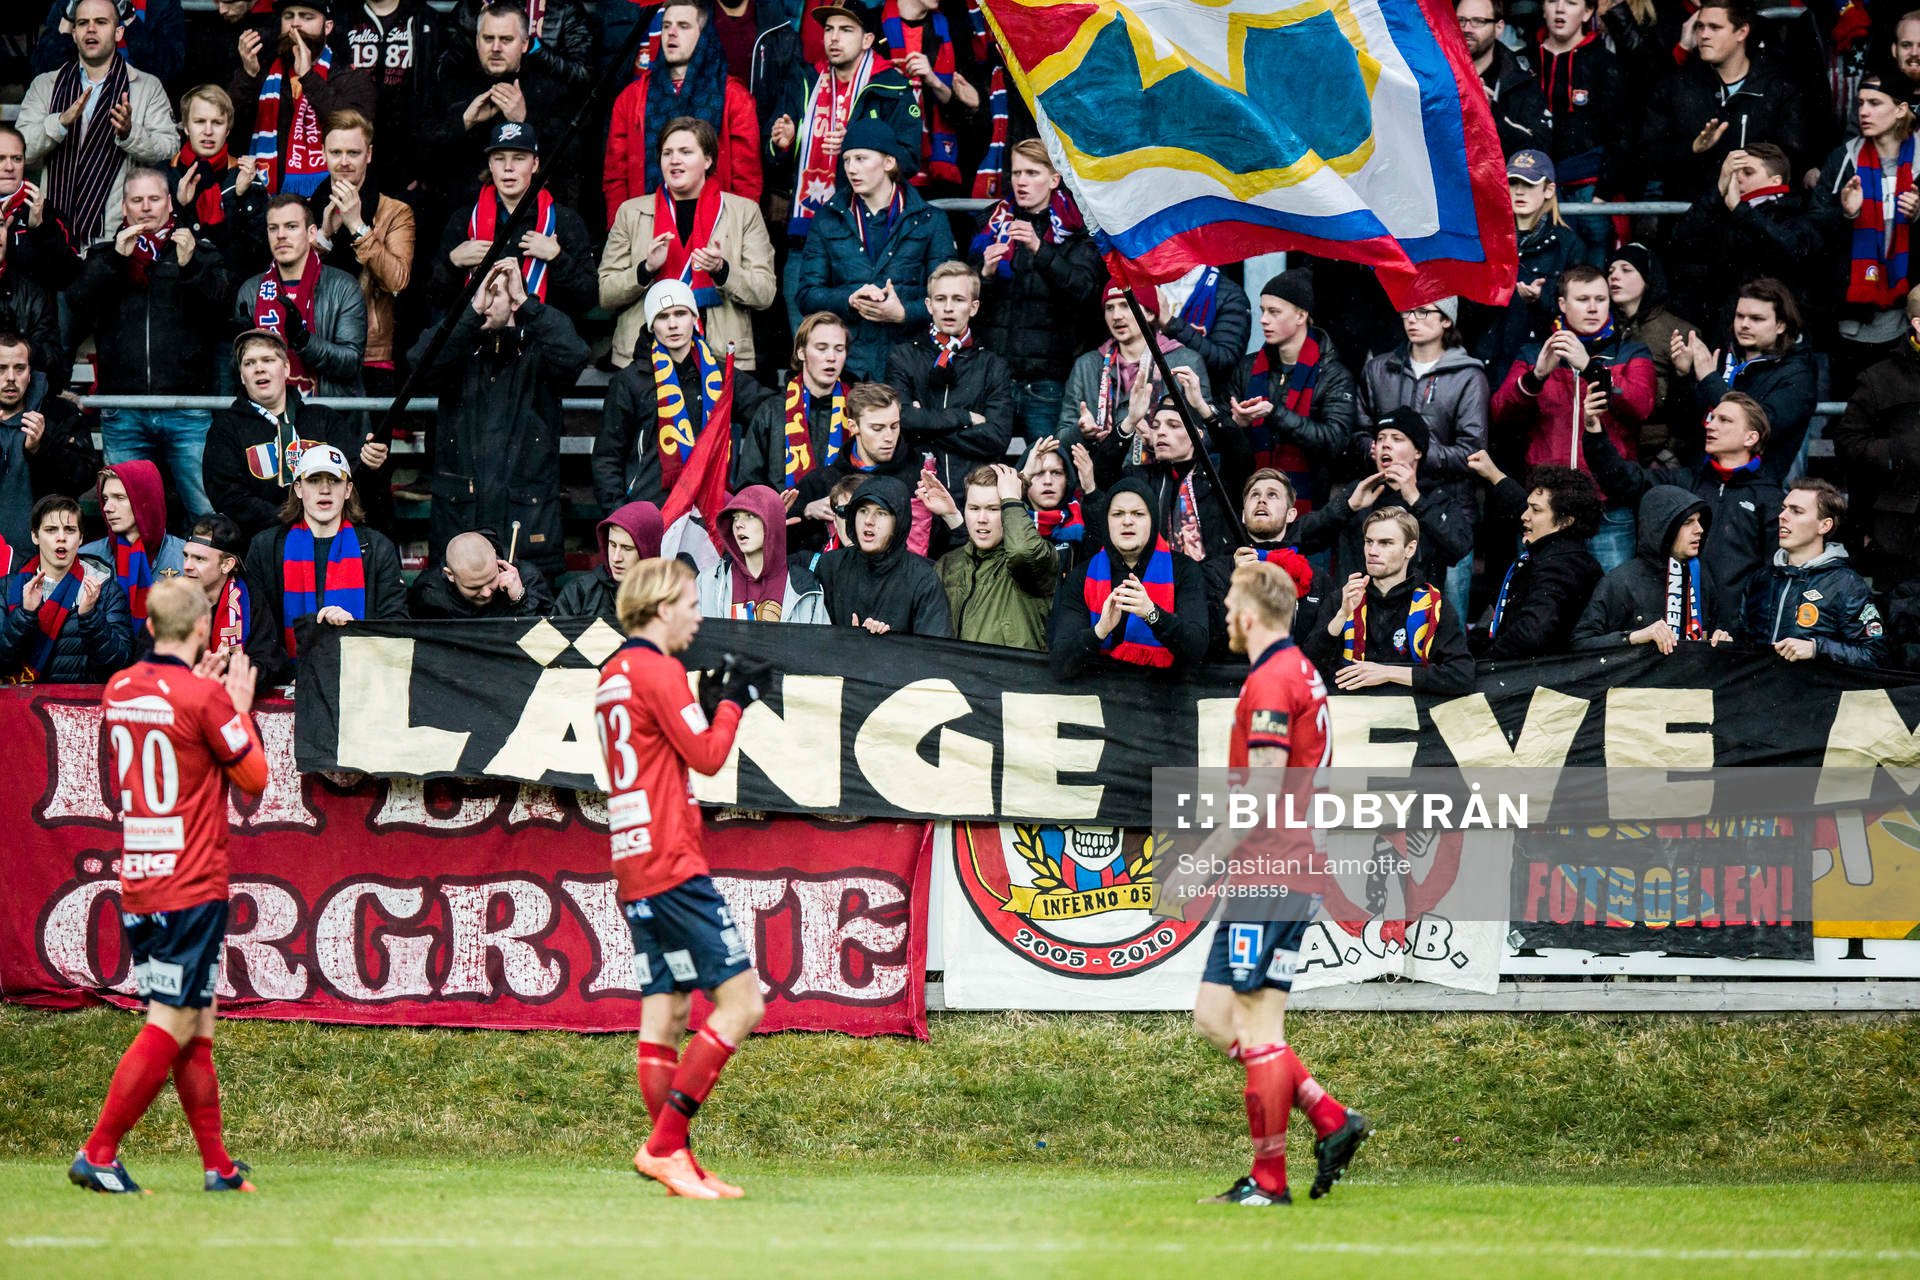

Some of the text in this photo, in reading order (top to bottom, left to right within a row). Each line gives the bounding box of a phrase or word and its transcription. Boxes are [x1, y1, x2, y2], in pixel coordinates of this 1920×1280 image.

[337, 617, 1106, 820] LÄNGE
[110, 724, 180, 815] 20
[1042, 890, 1118, 916] INFERNO
[1524, 862, 1793, 930] FOTBOLLEN!
[1013, 928, 1087, 968] 2005
[1108, 927, 1177, 968] 2010
